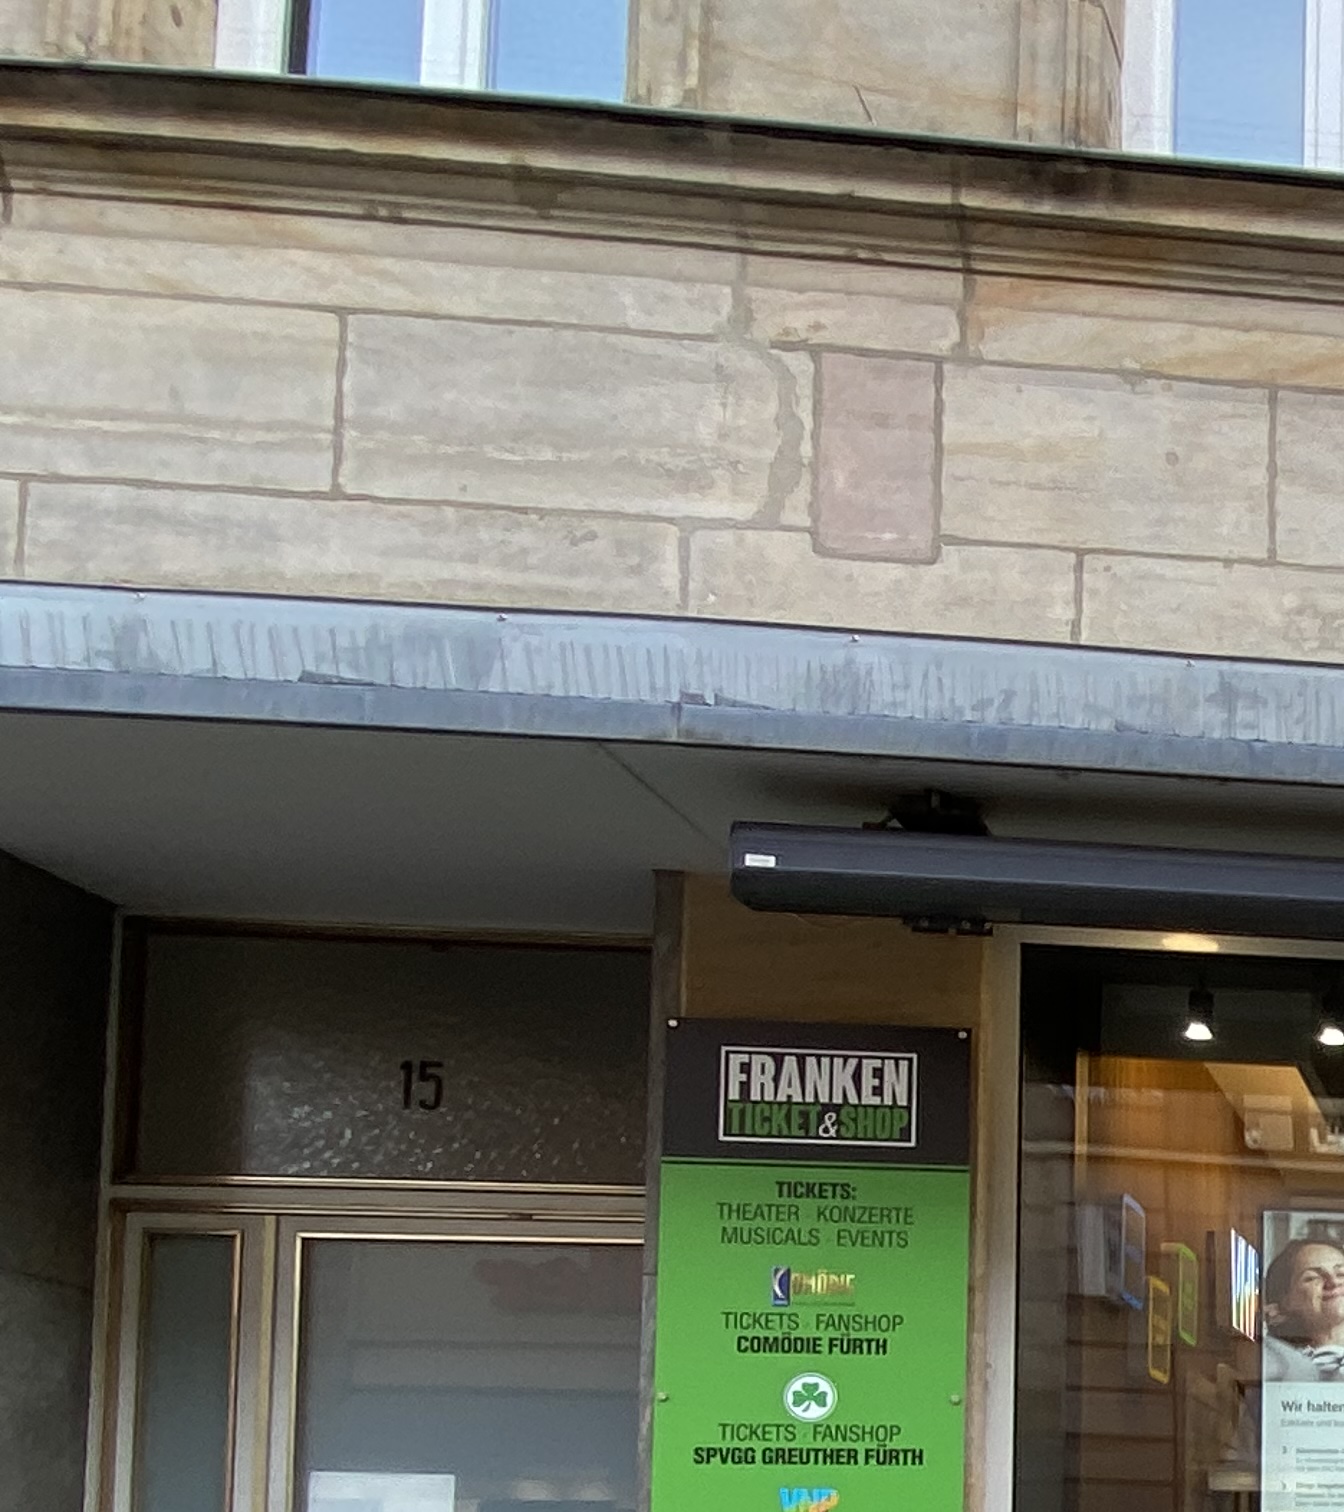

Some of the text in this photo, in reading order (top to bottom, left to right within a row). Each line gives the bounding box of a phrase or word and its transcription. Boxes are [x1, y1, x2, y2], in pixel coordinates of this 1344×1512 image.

[400, 1060, 444, 1110] 15
[727, 1053, 909, 1106] FRANKEN
[727, 1103, 910, 1140] TICKET&SHOP
[775, 1180, 857, 1201] TICKETS:
[716, 1202, 914, 1226] THEATER KONZERTE
[720, 1227, 909, 1249] MUSICALS EVENTS
[721, 1311, 904, 1334] TICKETS FANSHOP
[736, 1332, 888, 1357] COMÖDIE FÜRTH
[1280, 1400, 1302, 1413] Wir
[718, 1423, 902, 1444] TICKETS FANSHOP
[693, 1443, 924, 1467] SPVGG GREUTHER FÜRTH
